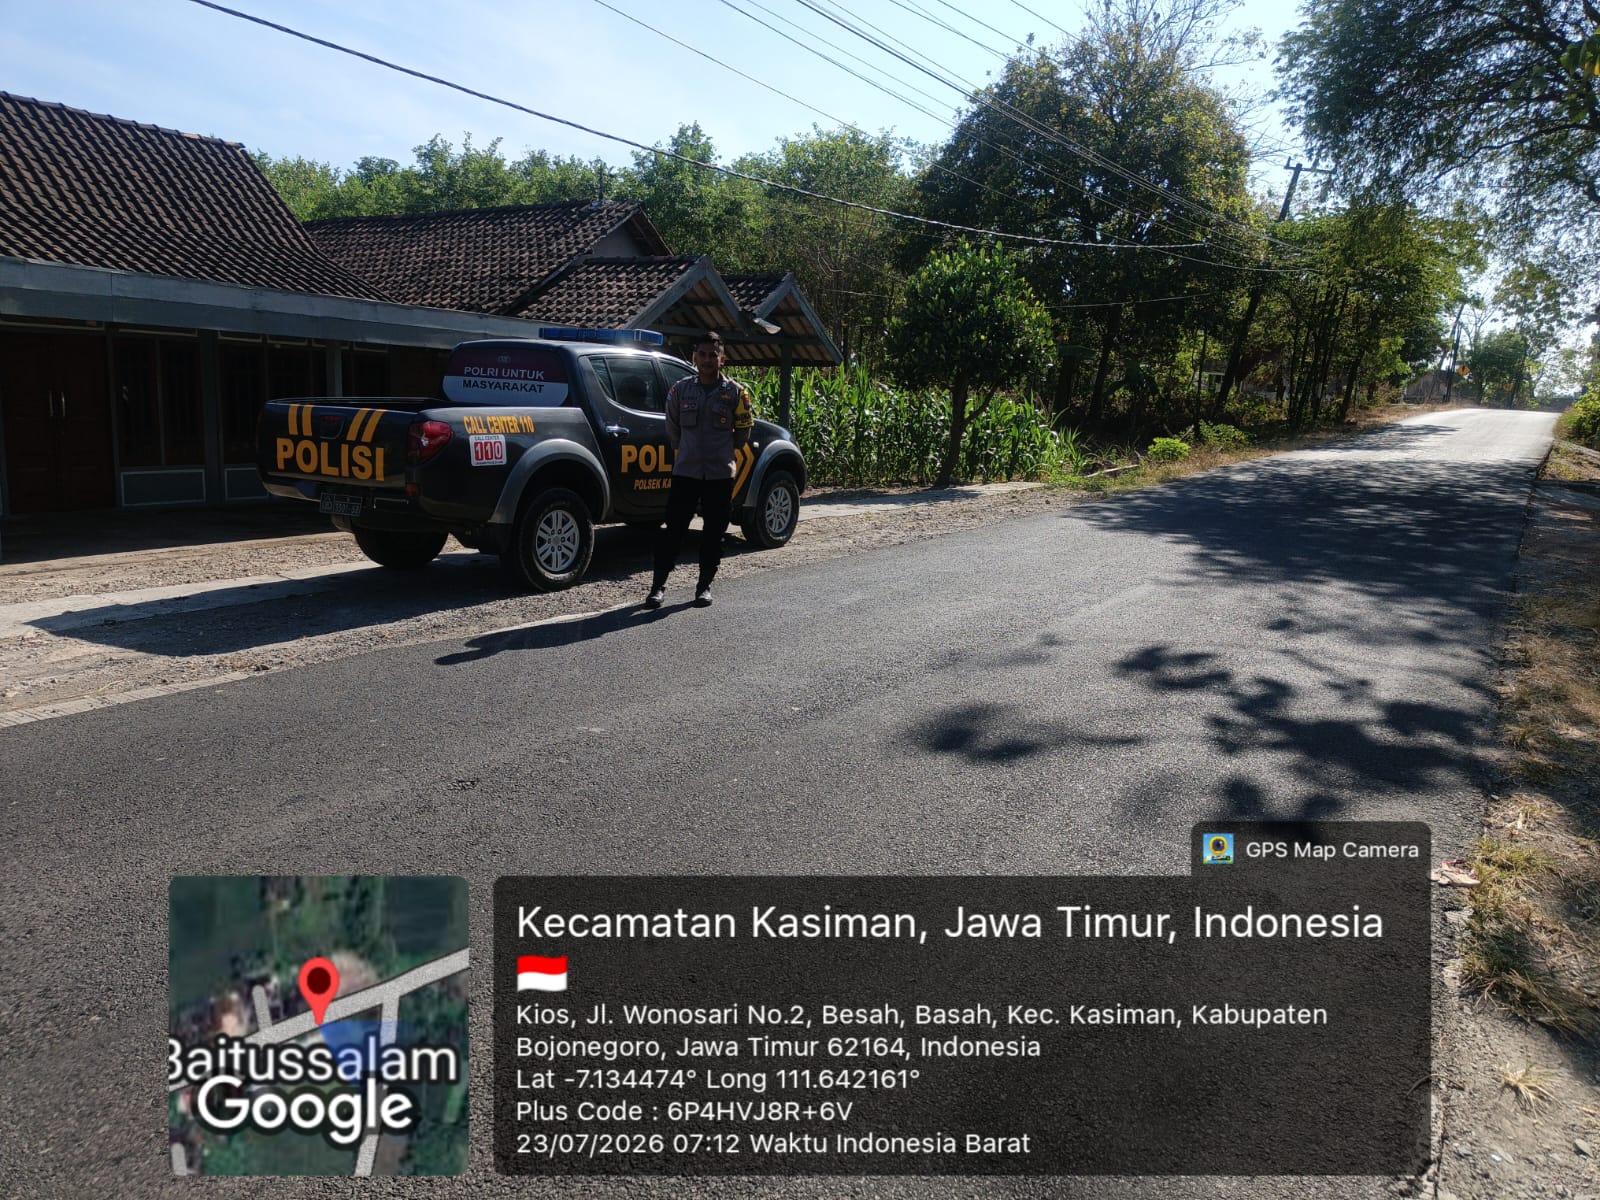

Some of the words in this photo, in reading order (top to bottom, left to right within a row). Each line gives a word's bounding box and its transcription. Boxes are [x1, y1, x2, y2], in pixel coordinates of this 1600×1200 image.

[463, 366, 499, 377] POLRI
[502, 368, 545, 380] UNTUK
[462, 379, 545, 394] MASYARAKAT
[463, 415, 488, 434] CALL
[486, 415, 520, 434] CENTER
[519, 415, 536, 433] 110
[475, 441, 502, 460] 110
[276, 437, 385, 482] POLISI
[633, 479, 661, 490] POLSEK
[662, 478, 673, 489] KA
